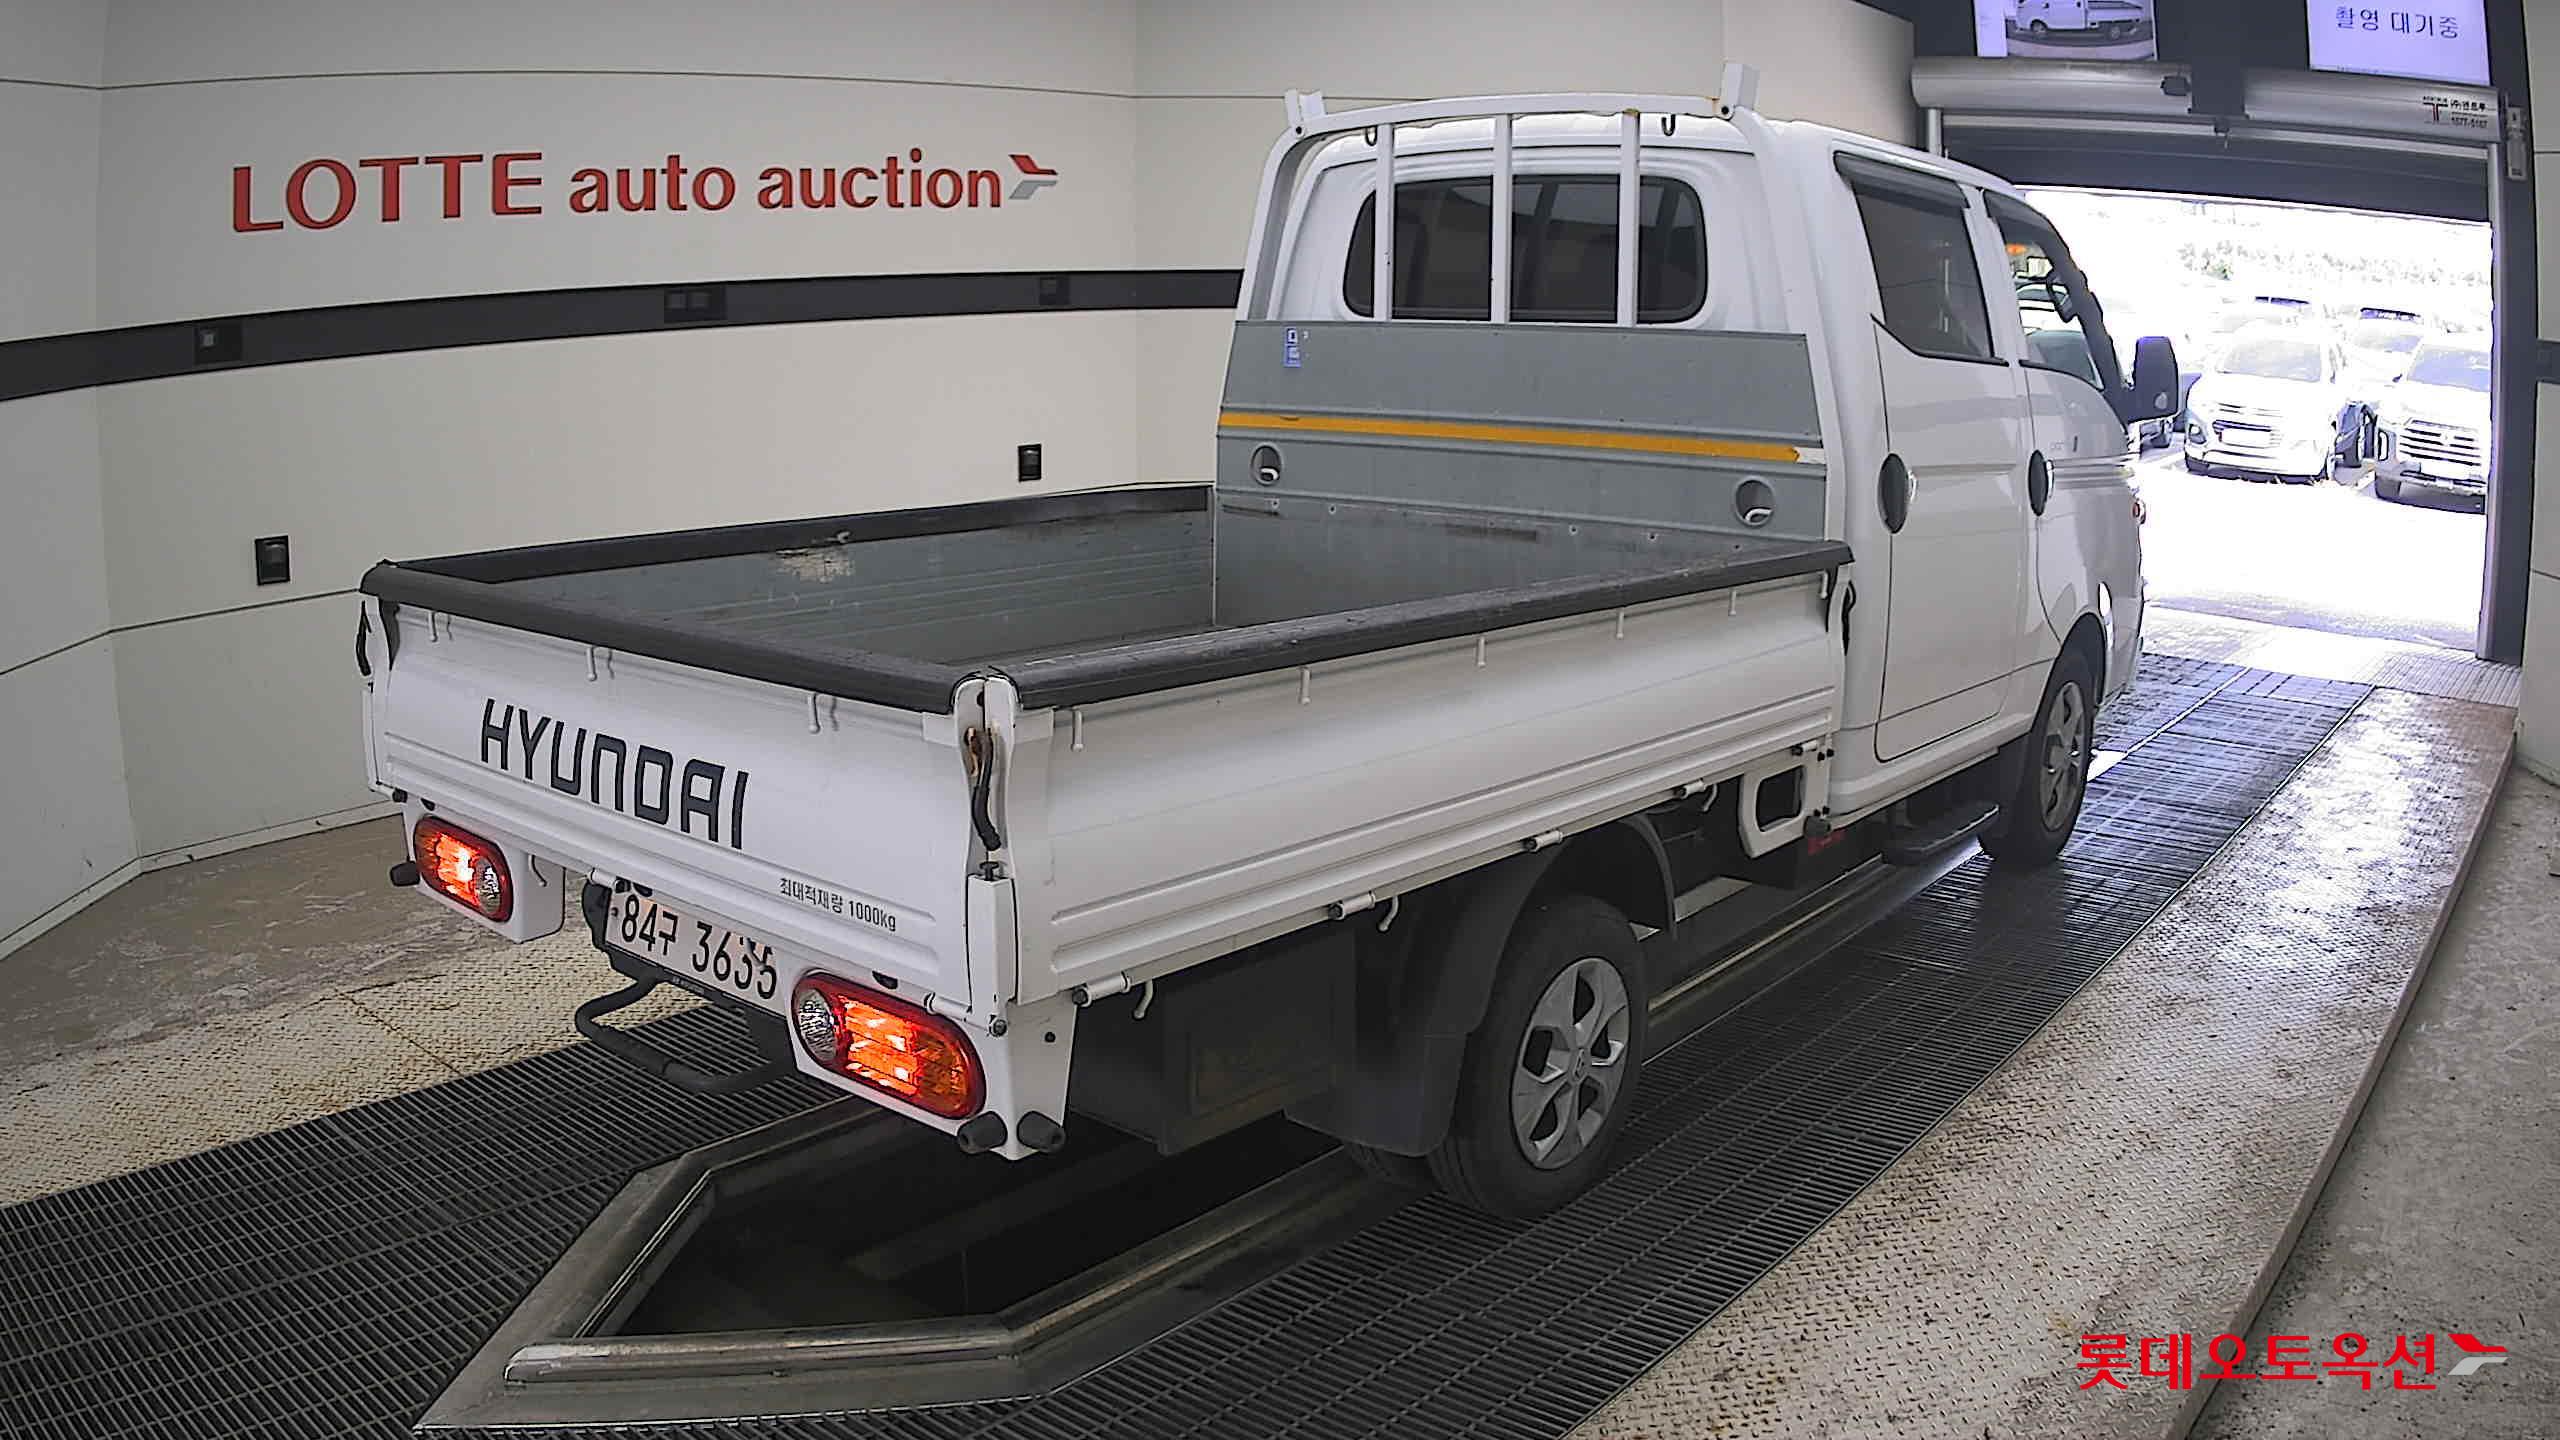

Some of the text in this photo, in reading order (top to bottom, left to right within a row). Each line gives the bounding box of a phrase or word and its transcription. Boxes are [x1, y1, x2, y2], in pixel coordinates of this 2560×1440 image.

[2336, 6, 2458, 39] 촬영 대기중
[233, 148, 1002, 232] LOTTE auto auction
[481, 698, 749, 849] HYUNDAI
[621, 894, 777, 999] 84구 3635
[780, 877, 896, 932] 최대적재량 1000kg
